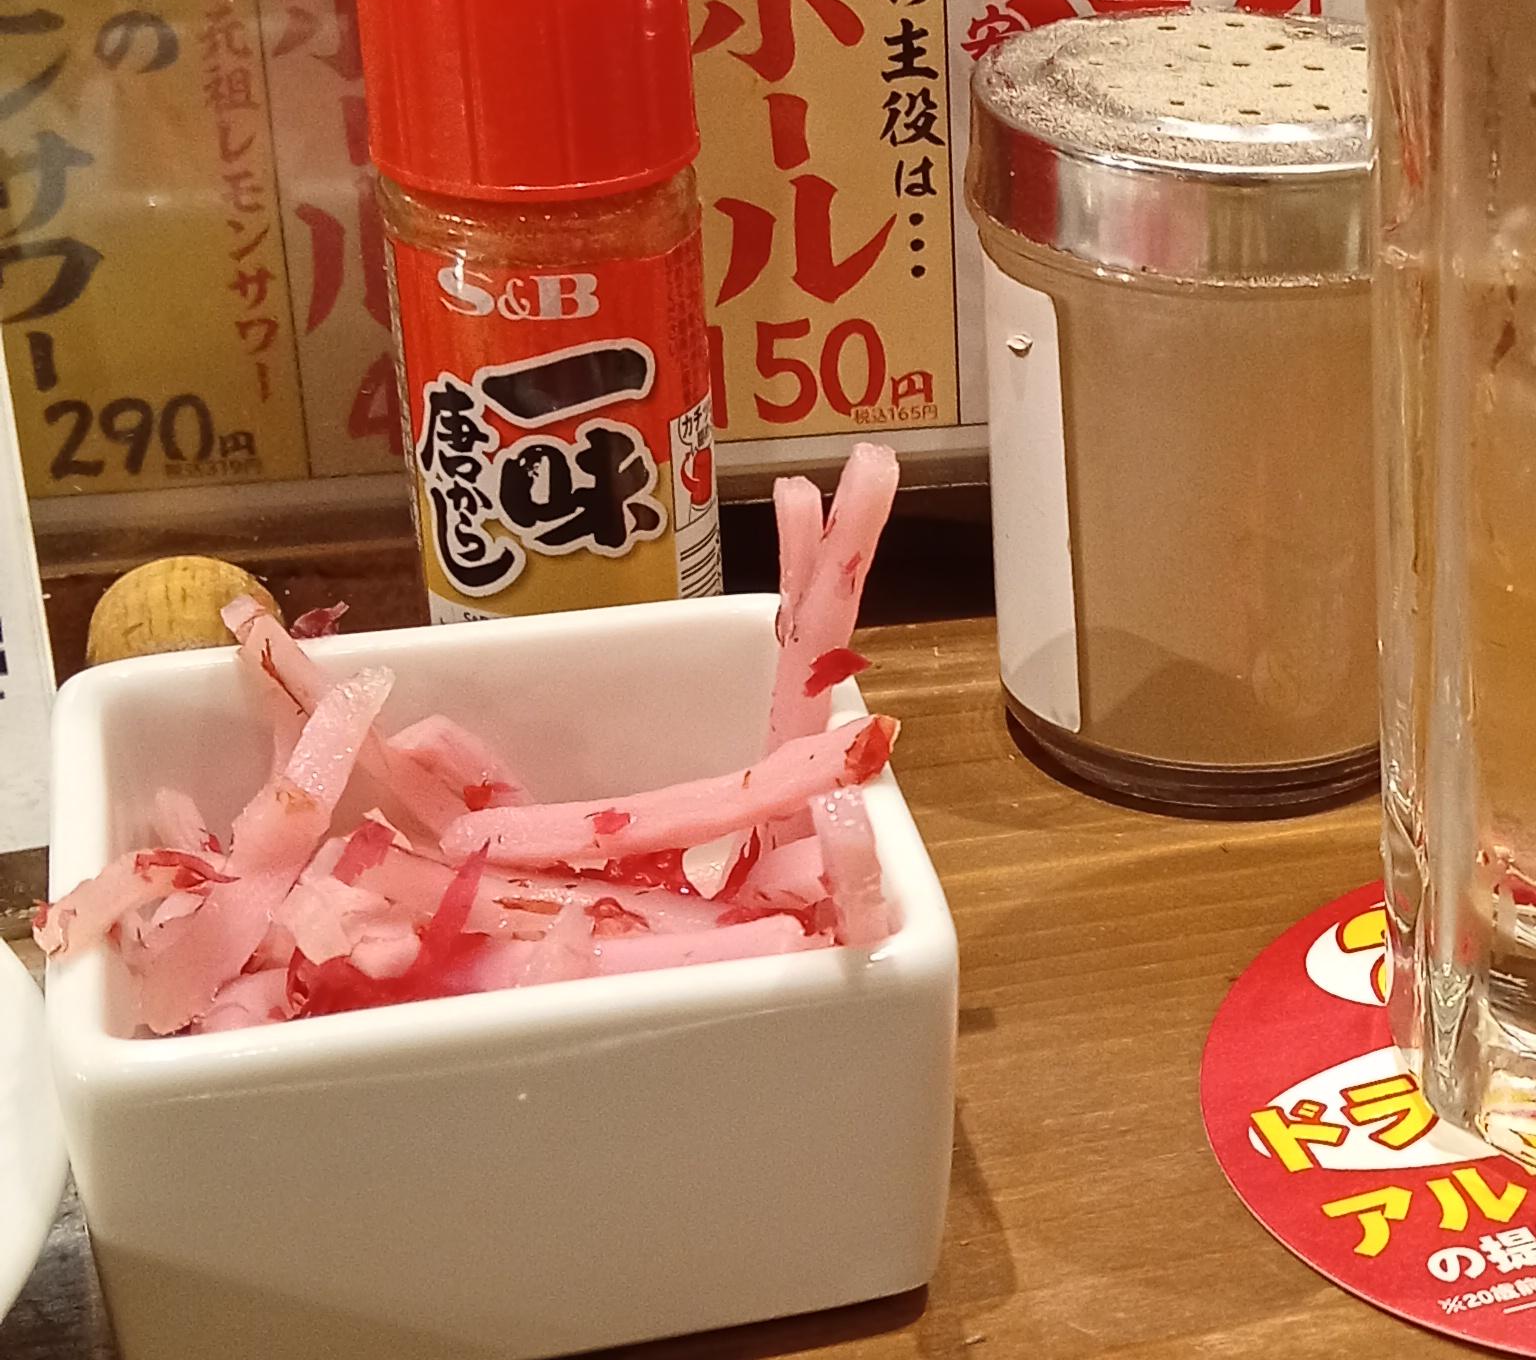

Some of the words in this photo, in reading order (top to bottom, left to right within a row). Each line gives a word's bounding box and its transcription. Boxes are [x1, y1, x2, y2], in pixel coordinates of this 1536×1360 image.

[437, 264, 600, 322] S&B
[44, 394, 258, 479] 290円
[480, 344, 663, 549] 一味
